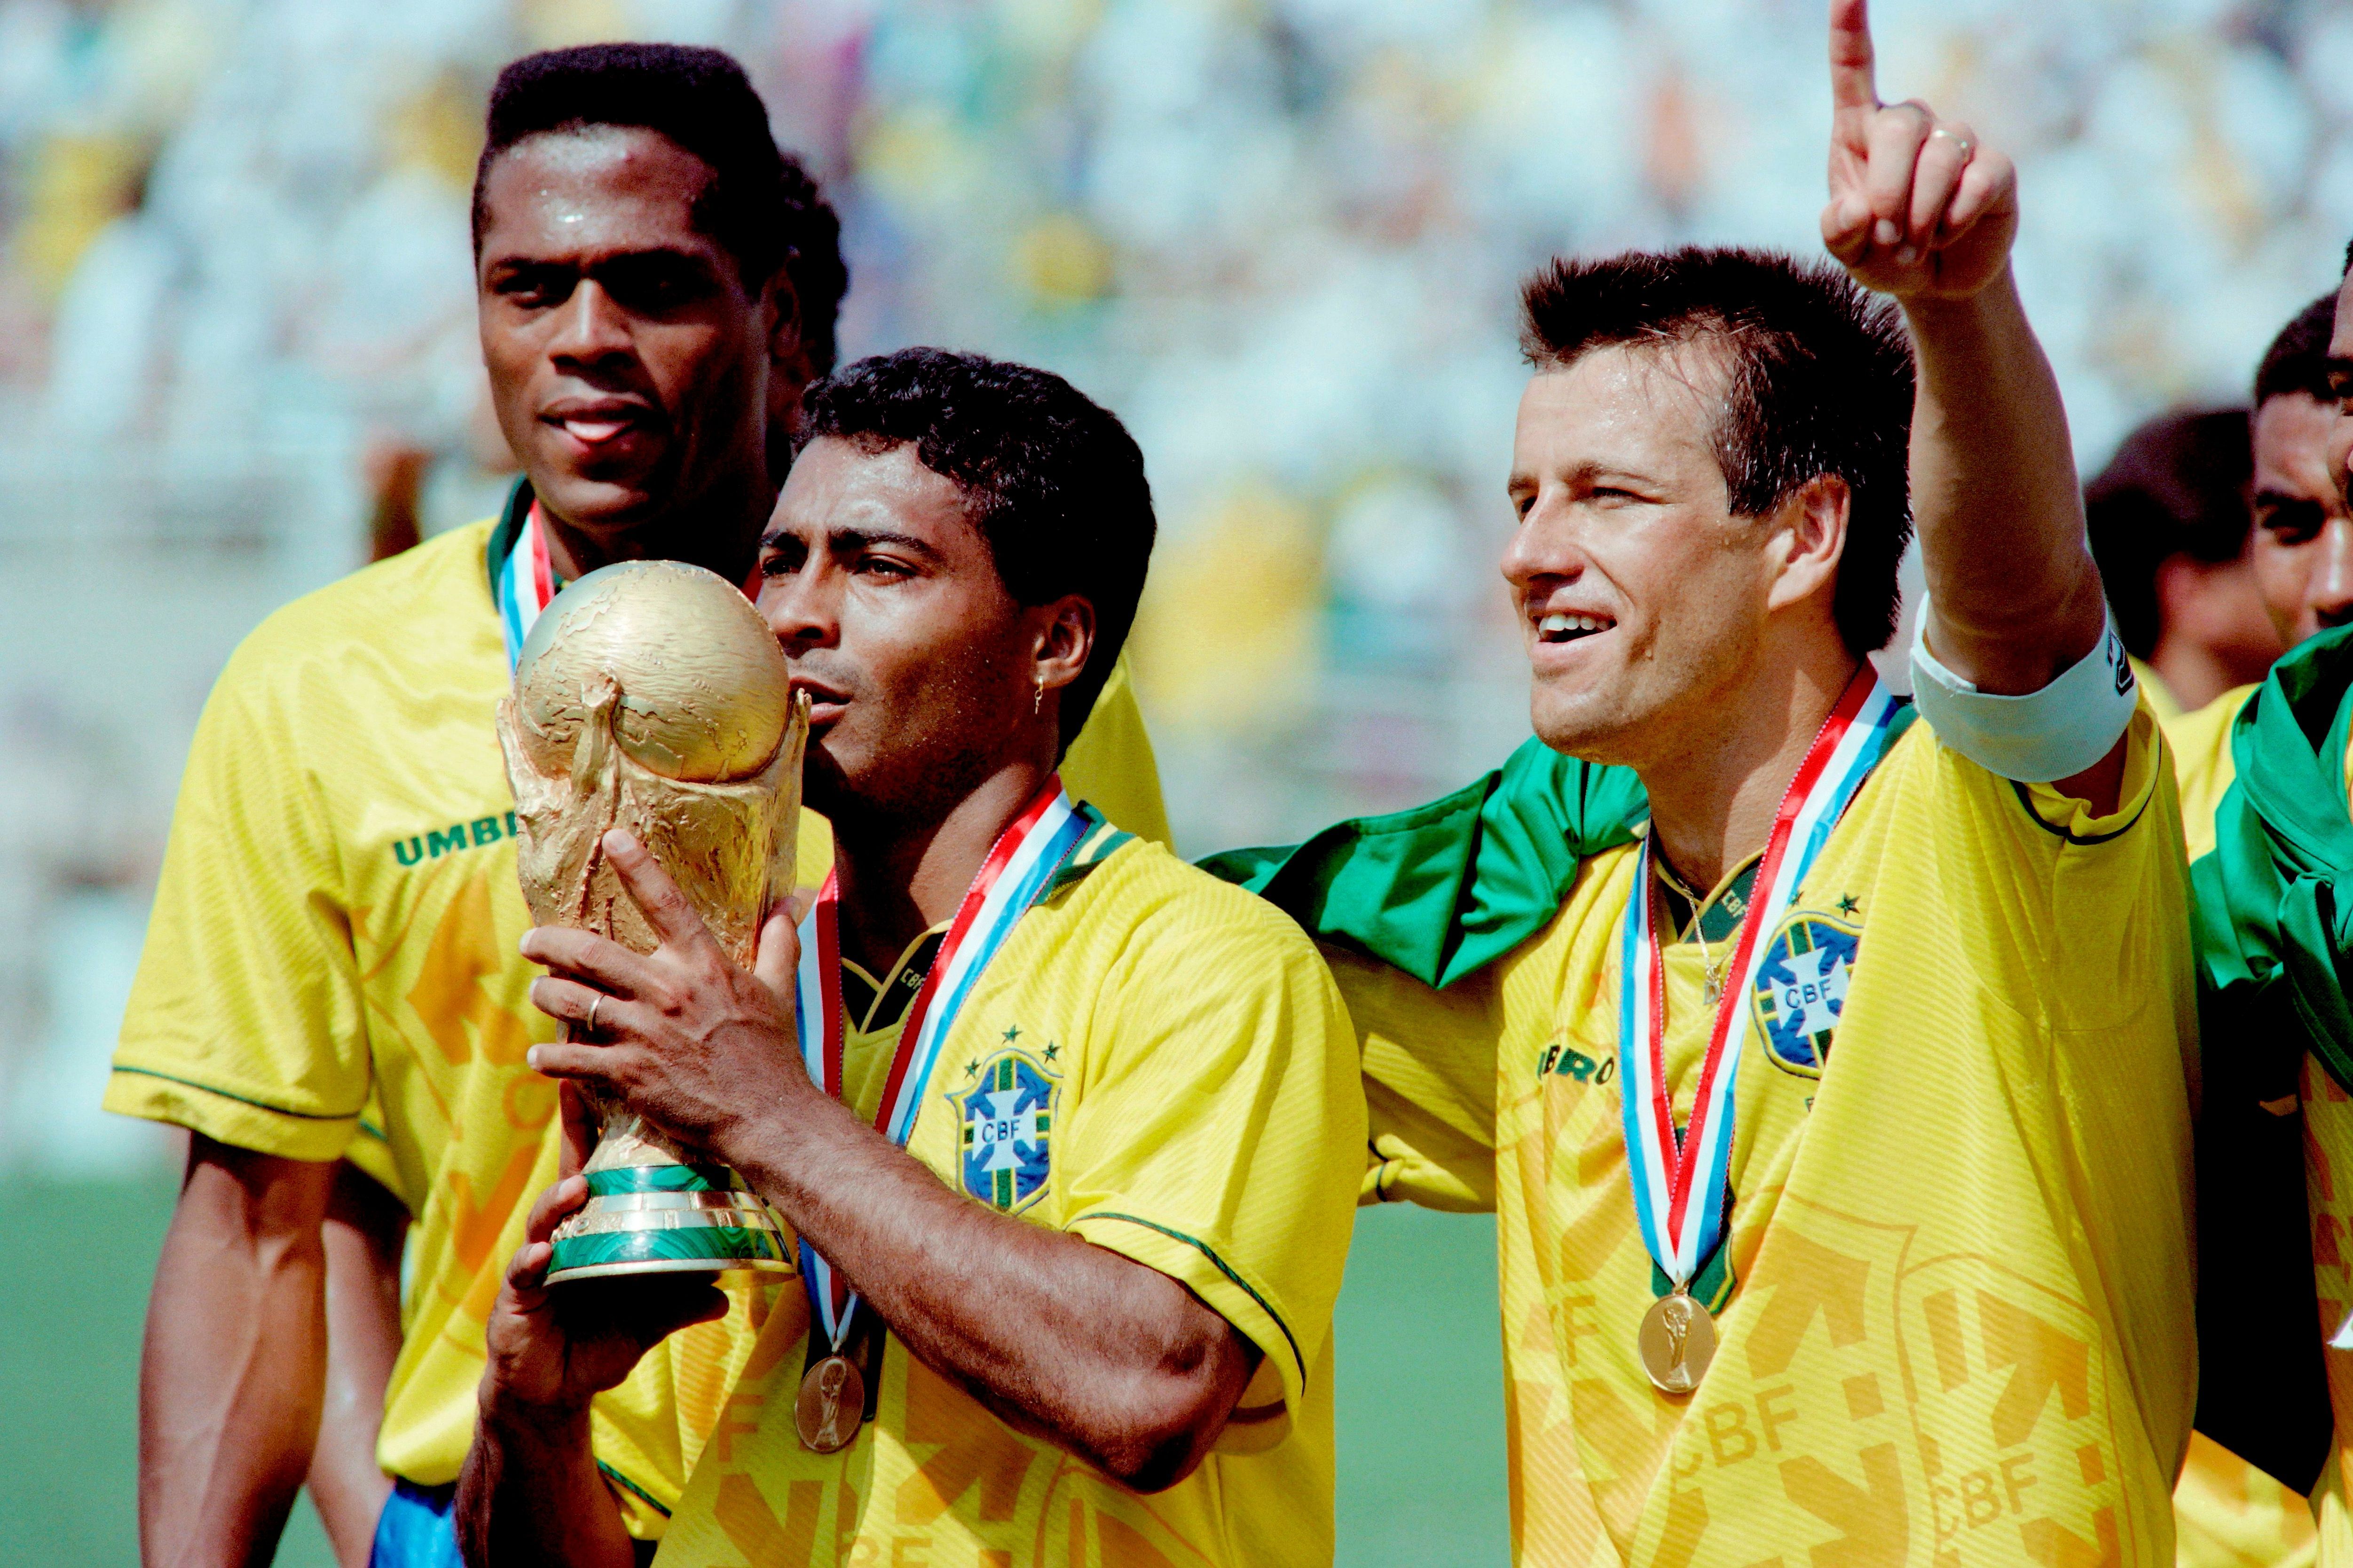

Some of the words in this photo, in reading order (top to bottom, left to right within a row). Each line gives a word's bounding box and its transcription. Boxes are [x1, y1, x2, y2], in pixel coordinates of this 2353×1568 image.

[392, 809, 517, 866] UMB
[1786, 978, 1832, 1008] CBF
[1536, 1044, 1614, 1085] BRO
[982, 1118, 1021, 1144] CBF
[1930, 1452, 2038, 1539] CBF
